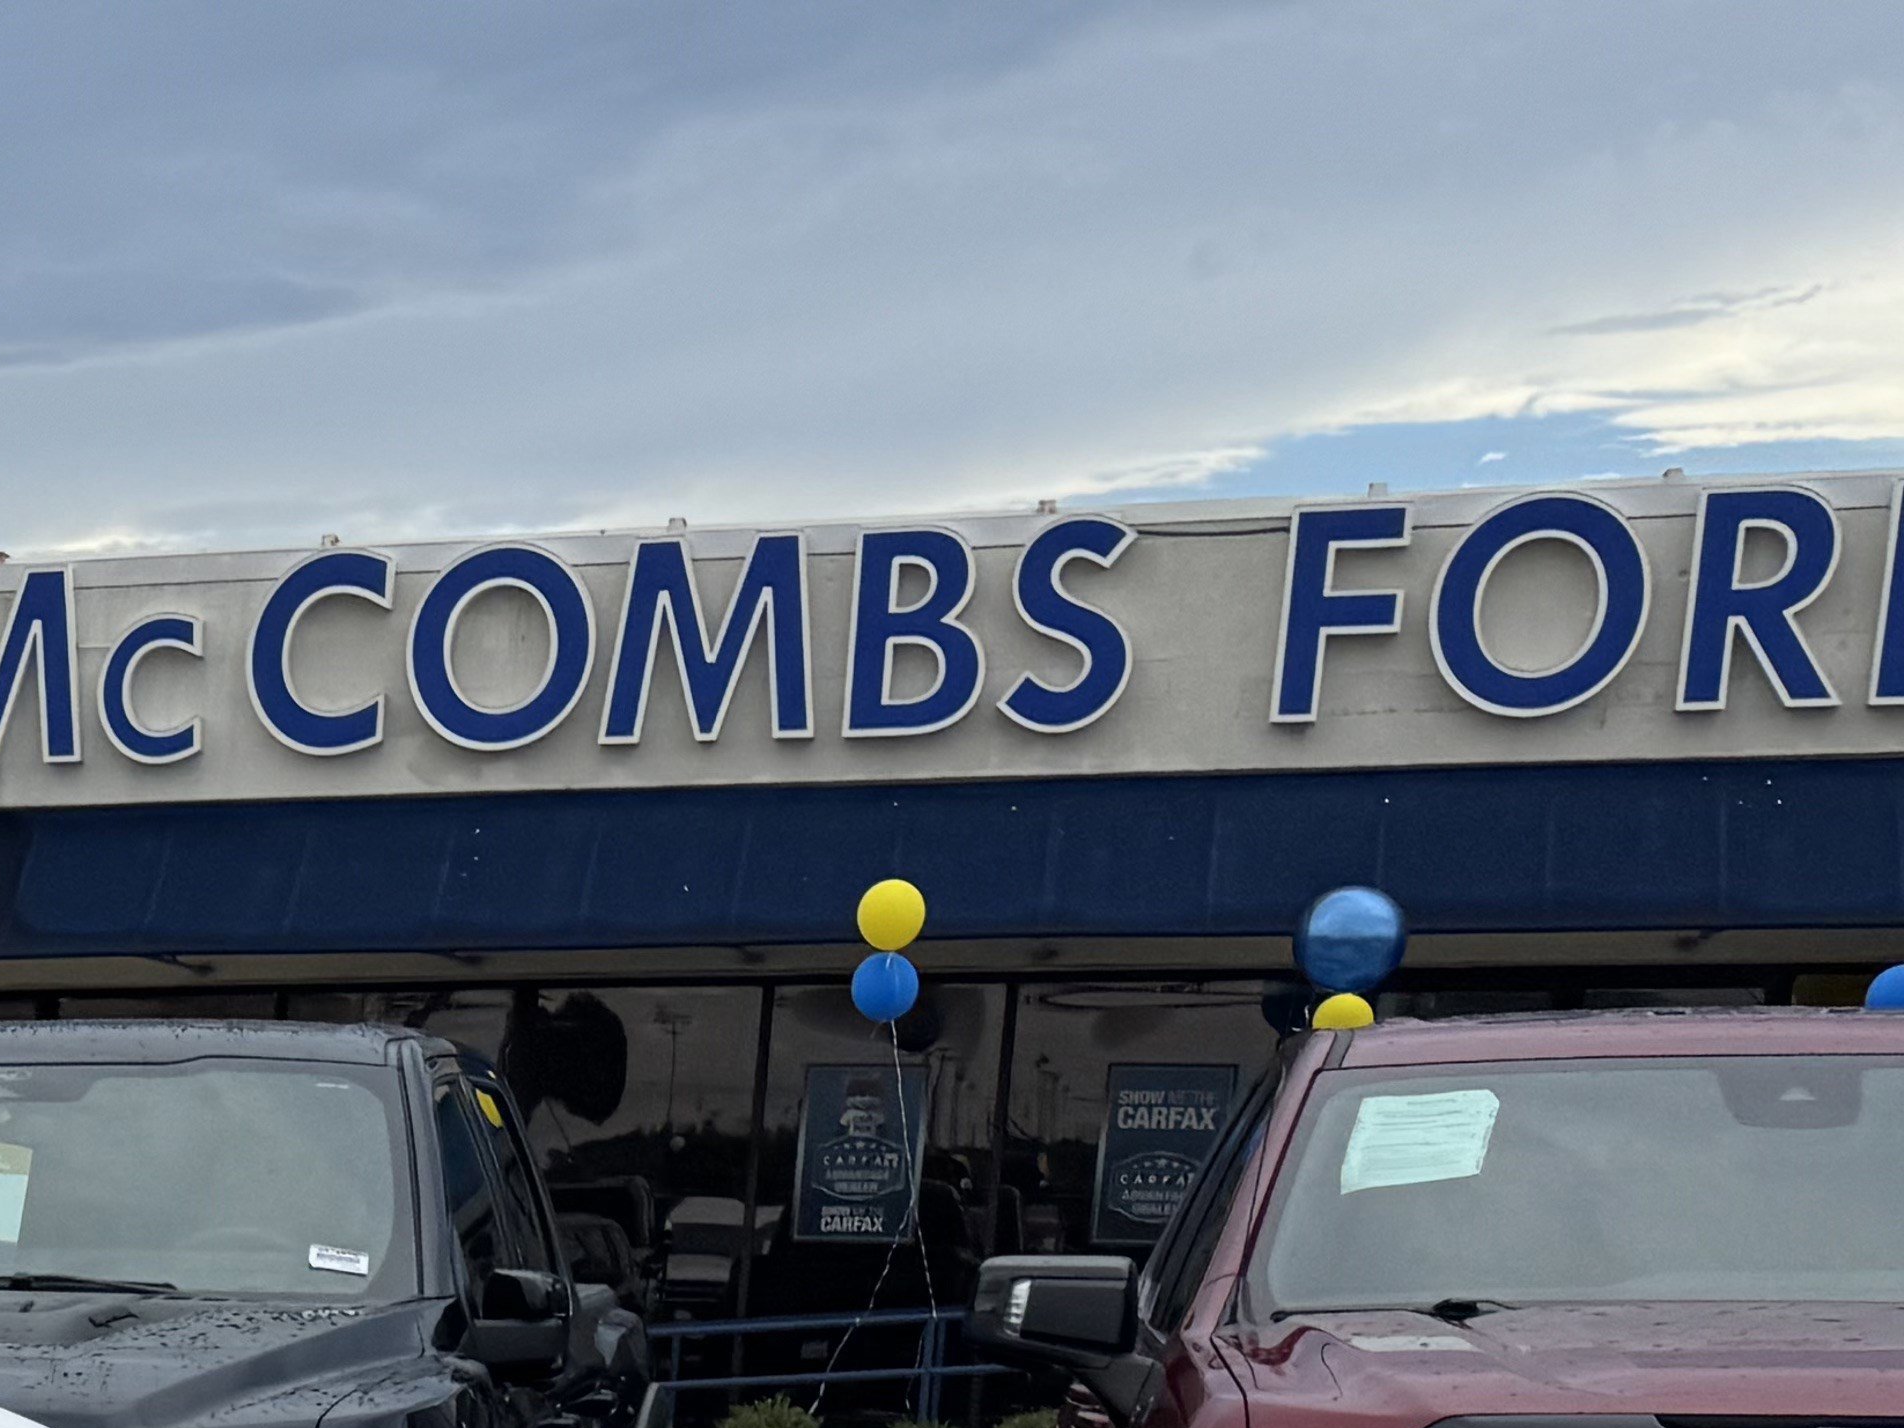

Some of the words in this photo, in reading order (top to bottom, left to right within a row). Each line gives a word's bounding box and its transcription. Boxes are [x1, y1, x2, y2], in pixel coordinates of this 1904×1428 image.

[1269, 480, 1904, 723] FOR
[1117, 1106, 1217, 1130] CARFAX
[820, 1215, 883, 1233] CARFAX
